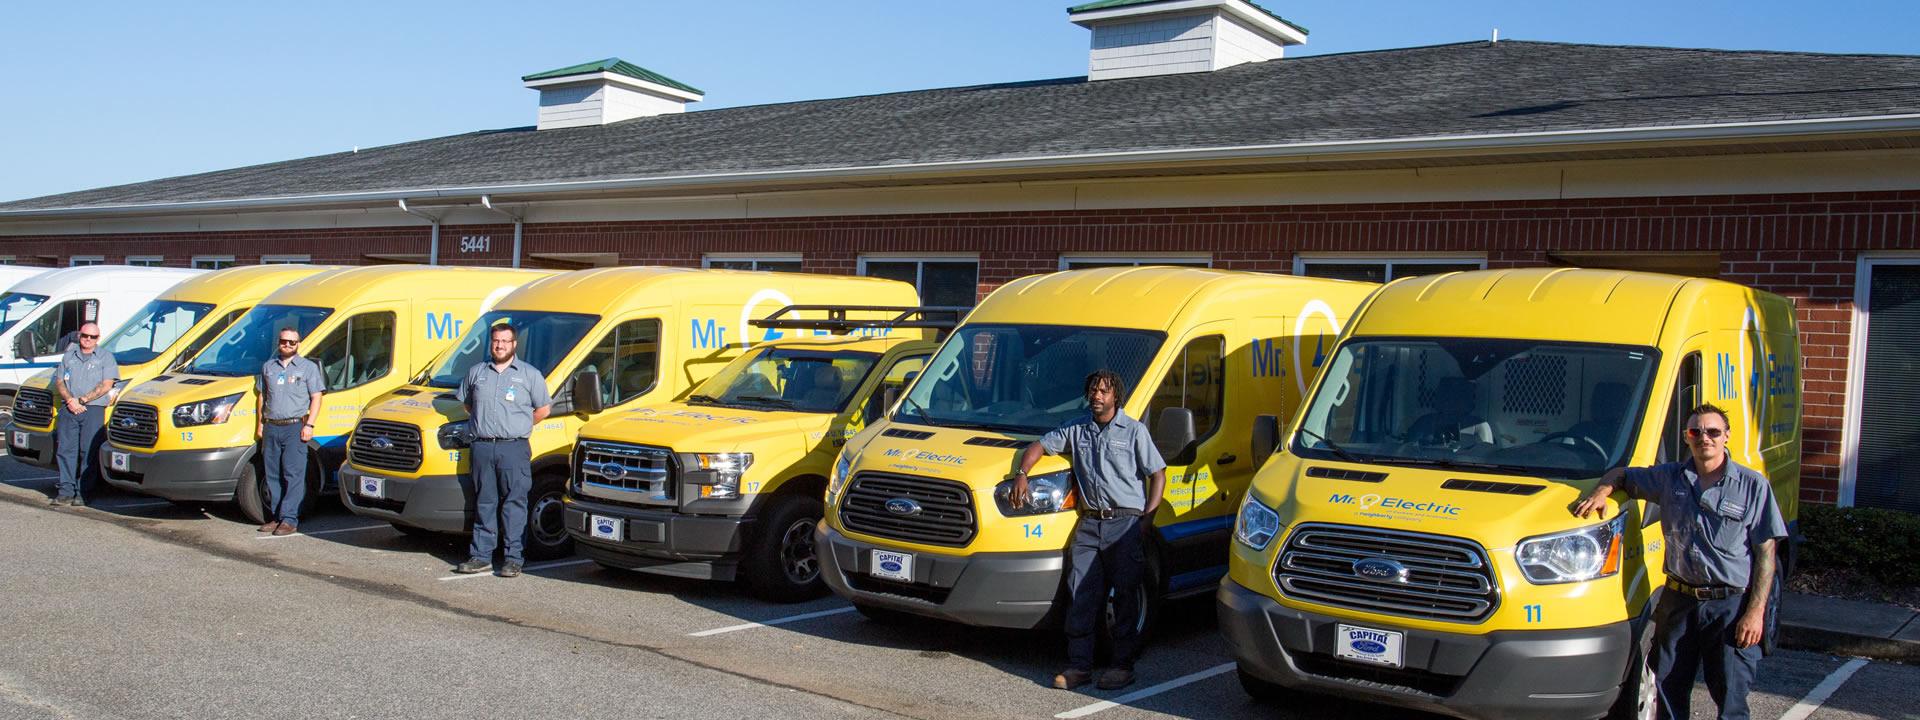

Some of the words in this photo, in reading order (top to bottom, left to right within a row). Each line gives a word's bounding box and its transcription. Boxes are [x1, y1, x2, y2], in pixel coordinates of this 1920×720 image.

[460, 235, 491, 253] 5441
[691, 318, 731, 350] Mr.
[1251, 337, 1287, 378] Mr.
[1717, 352, 1738, 401] Mr.
[180, 431, 194, 442] 13
[449, 451, 462, 462] 15
[915, 451, 968, 465] Electric
[747, 481, 760, 492] 17
[1328, 493, 1356, 505] Mr.
[1380, 497, 1462, 516] Electric
[1022, 523, 1043, 539] 14
[1523, 604, 1542, 623] 11
[1349, 630, 1389, 645] CAPITAL
